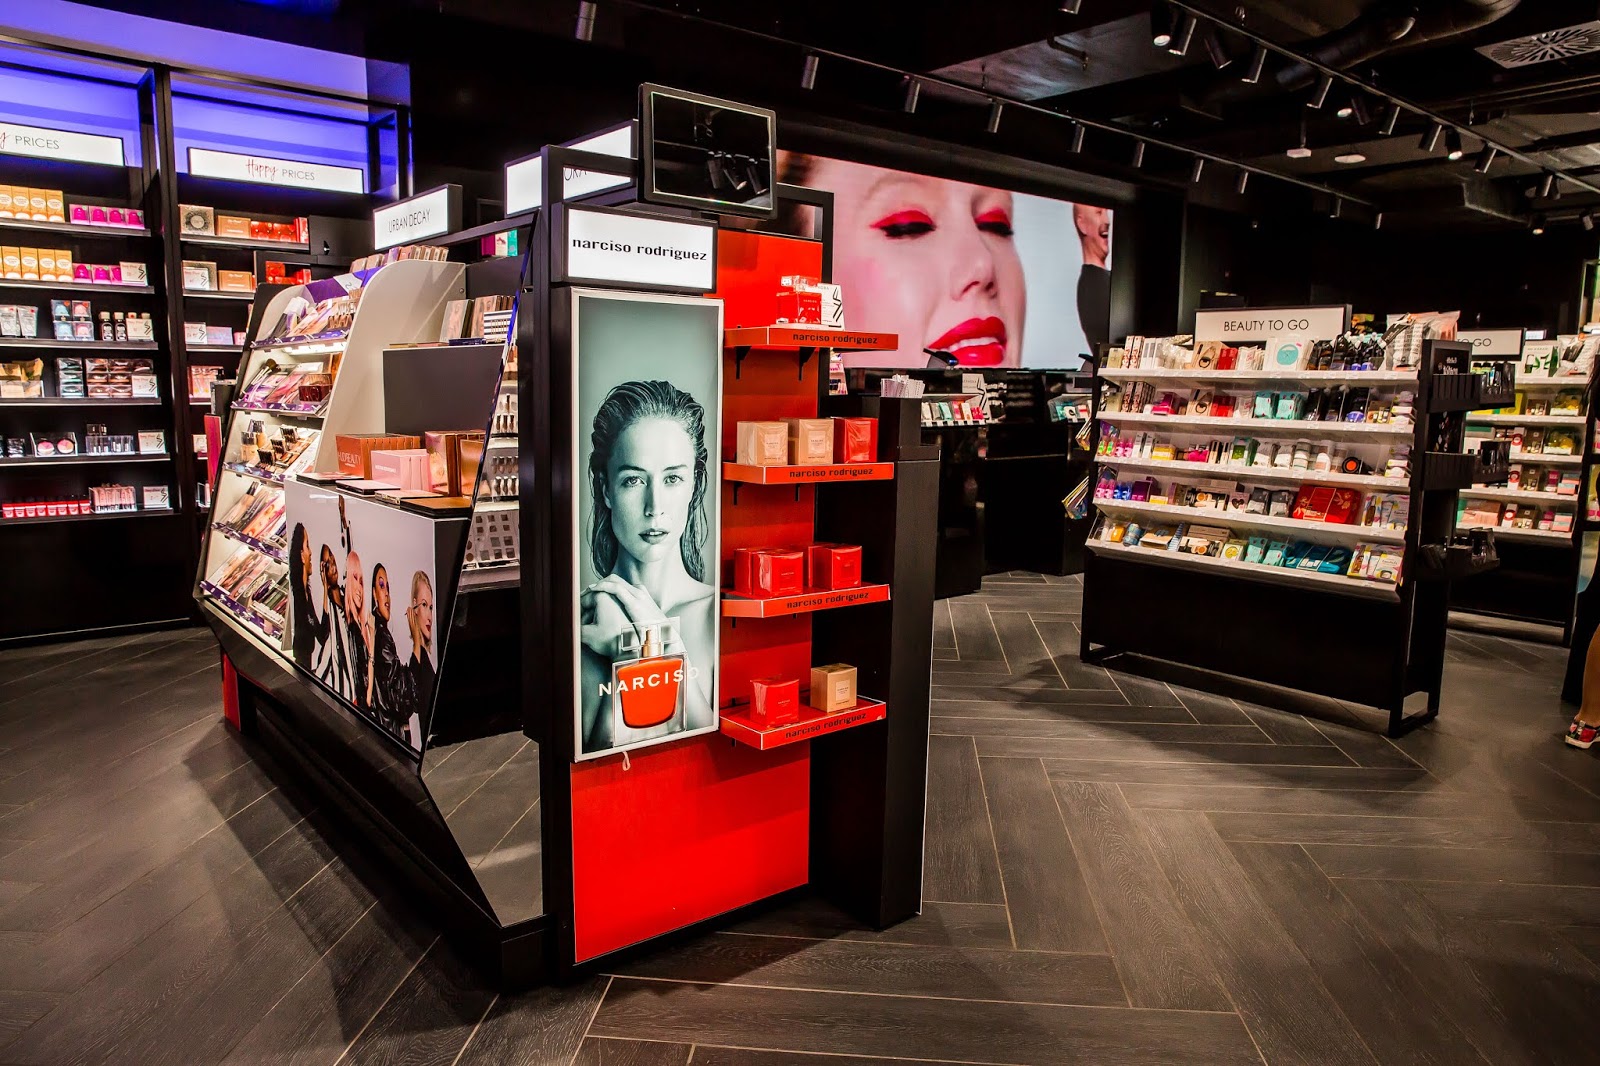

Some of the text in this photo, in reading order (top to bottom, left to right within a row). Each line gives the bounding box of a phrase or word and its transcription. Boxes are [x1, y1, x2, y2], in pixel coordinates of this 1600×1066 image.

[14, 134, 60, 150] PRICES
[245, 158, 315, 182] Happy PRICES
[388, 209, 431, 233] URBAN DECAY
[572, 237, 708, 261] narciso rodriguez
[1223, 318, 1309, 332] BEAUTY TO GO
[792, 332, 878, 345] narciso rodriguez
[1473, 338, 1492, 347] GO
[789, 466, 873, 478] narciso rodriguez
[786, 591, 869, 609] narciso rodriguez
[598, 667, 699, 697] NARCISO
[785, 712, 867, 739] narciso rodriguez
